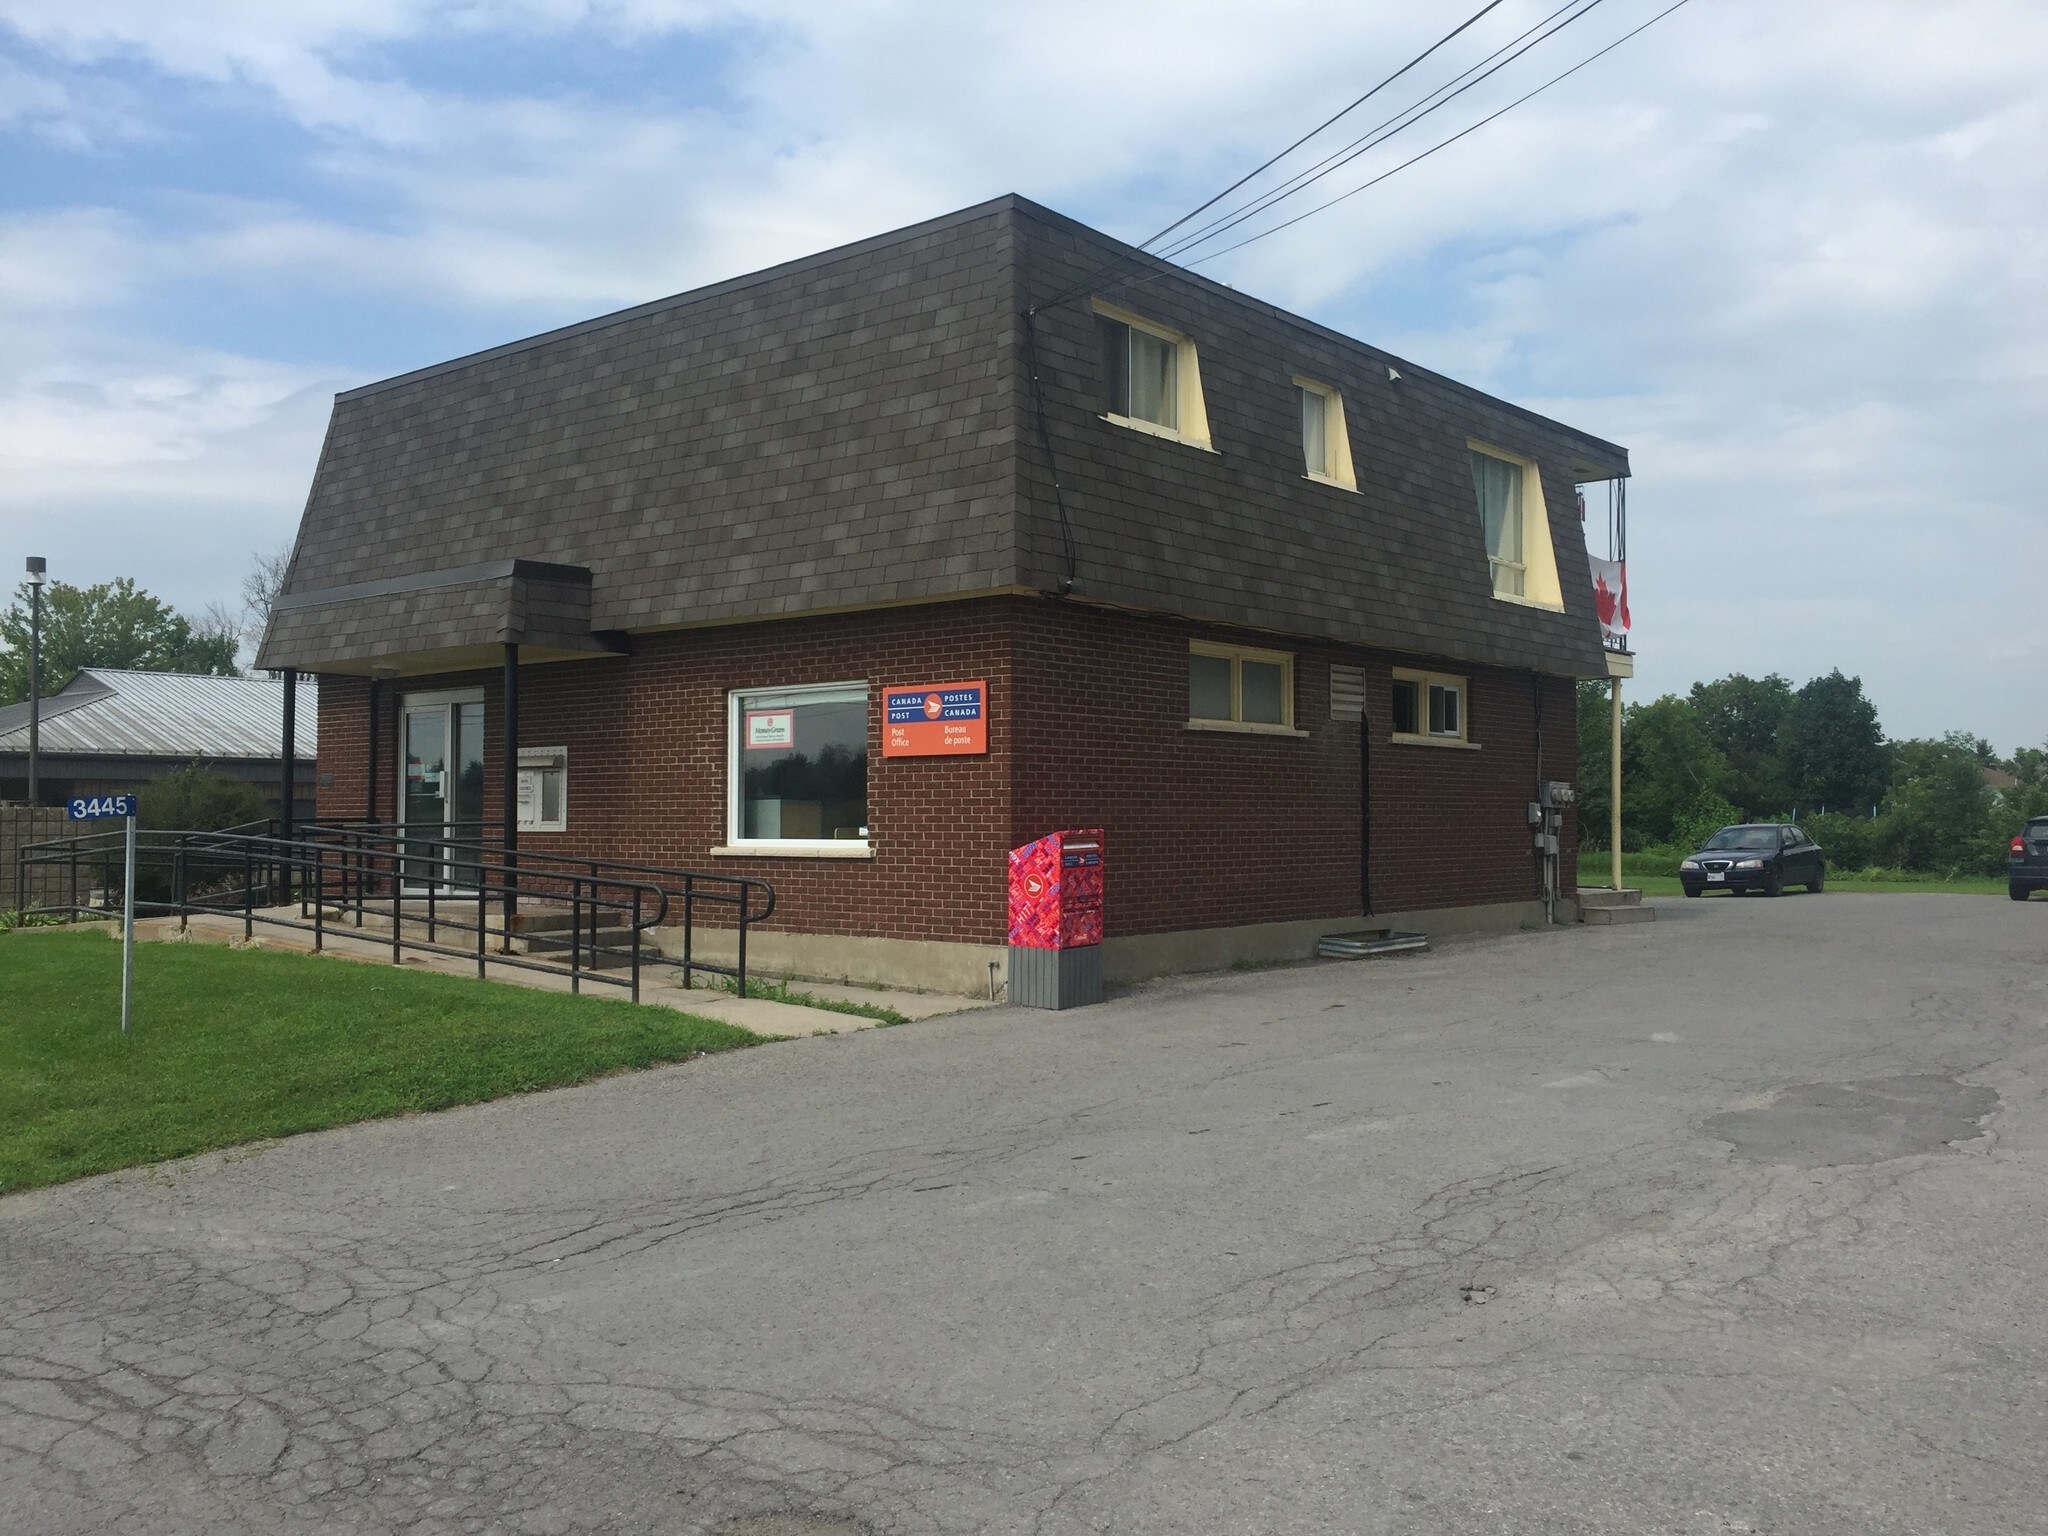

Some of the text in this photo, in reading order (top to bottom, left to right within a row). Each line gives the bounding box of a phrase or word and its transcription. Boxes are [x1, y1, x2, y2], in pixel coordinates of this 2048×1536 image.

[891, 697, 922, 706] CANADA
[944, 694, 973, 702] POSTES
[891, 712, 910, 720] POST
[944, 708, 976, 716] CANADA
[891, 728, 905, 736] Post
[944, 725, 966, 734] Bureau
[891, 739, 910, 747] Office
[944, 736, 971, 746] de poste
[73, 796, 128, 819] 3445
